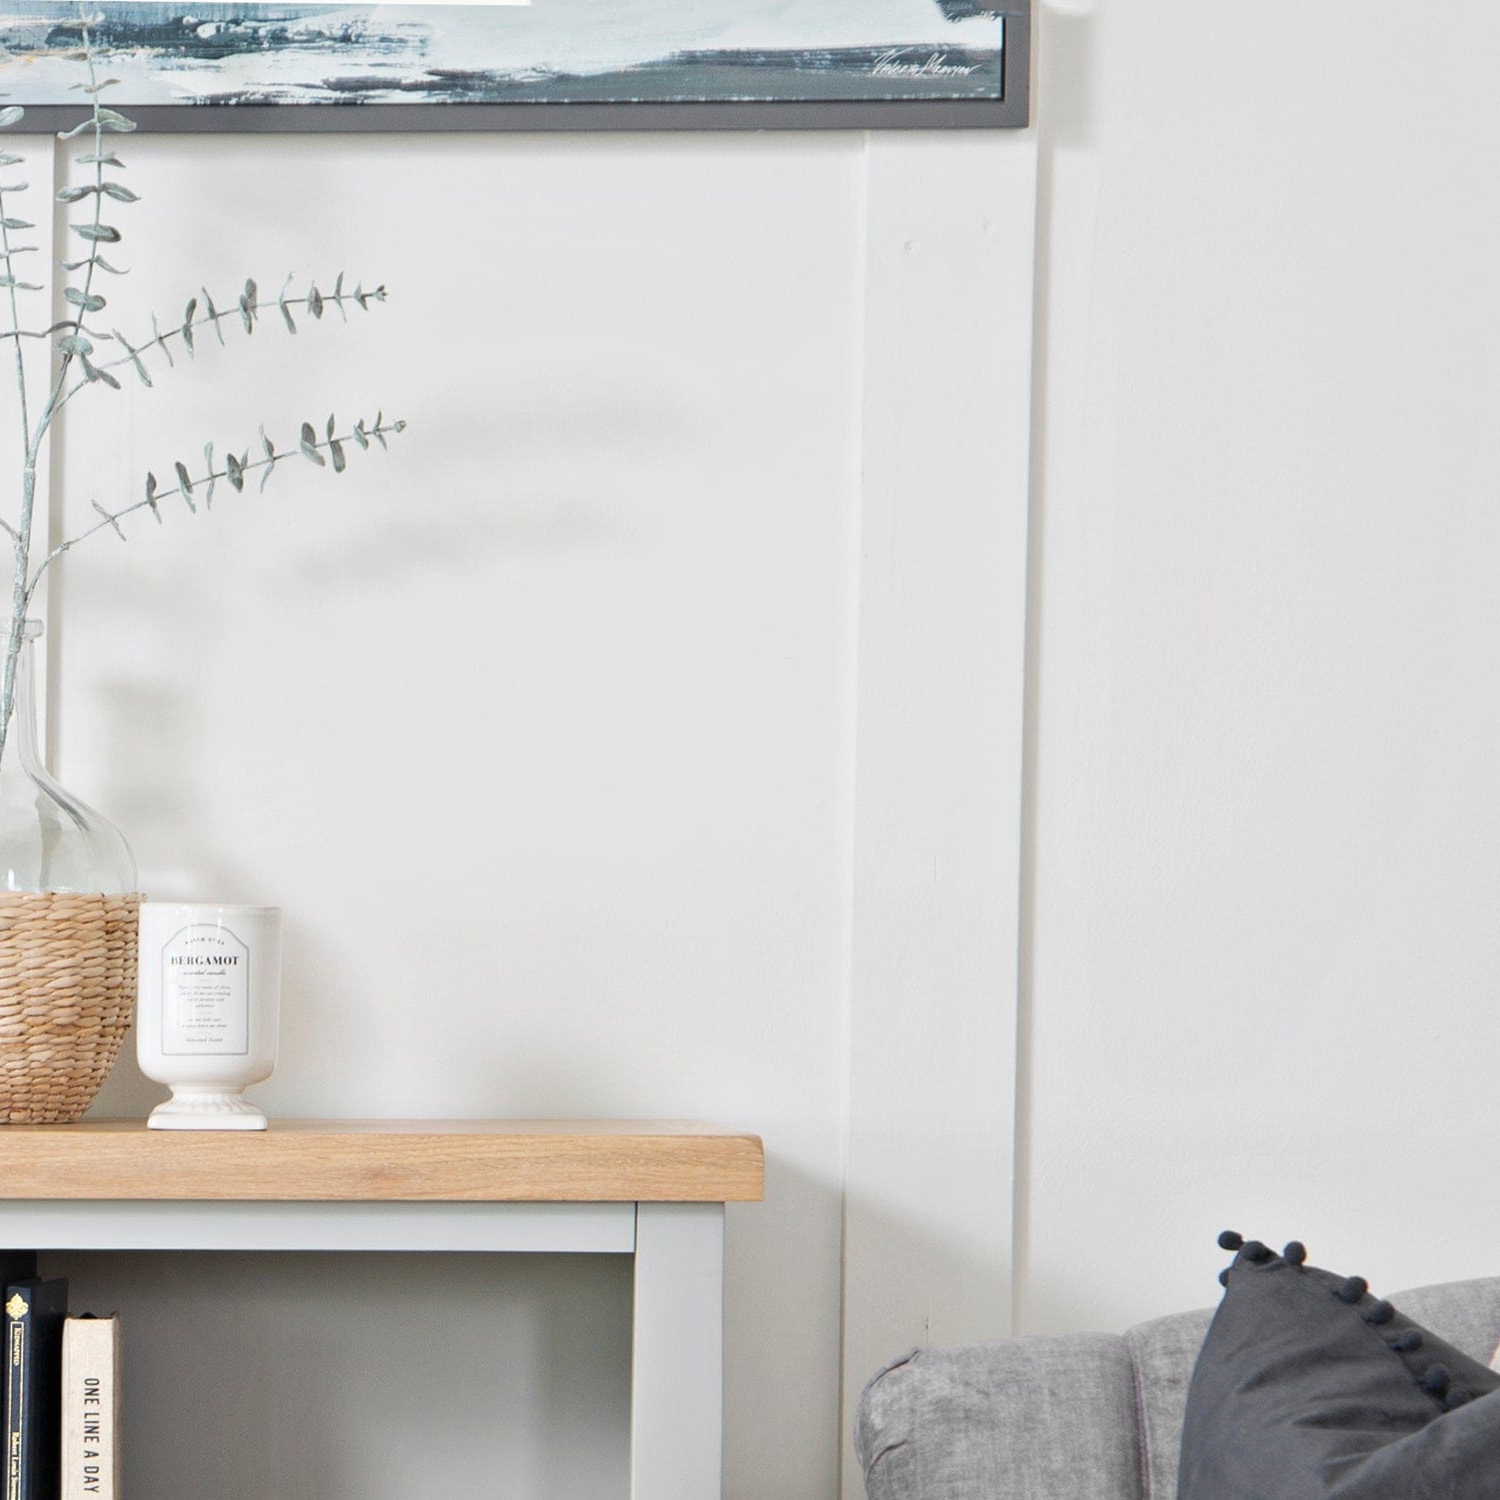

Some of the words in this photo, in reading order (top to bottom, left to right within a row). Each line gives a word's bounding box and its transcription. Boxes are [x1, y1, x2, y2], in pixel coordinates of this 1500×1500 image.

[171, 956, 239, 966] BERGAMOT
[84, 1378, 100, 1406] ONE
[83, 1411, 100, 1444] LINE
[84, 1449, 100, 1459] A
[83, 1465, 99, 1494] DAY
